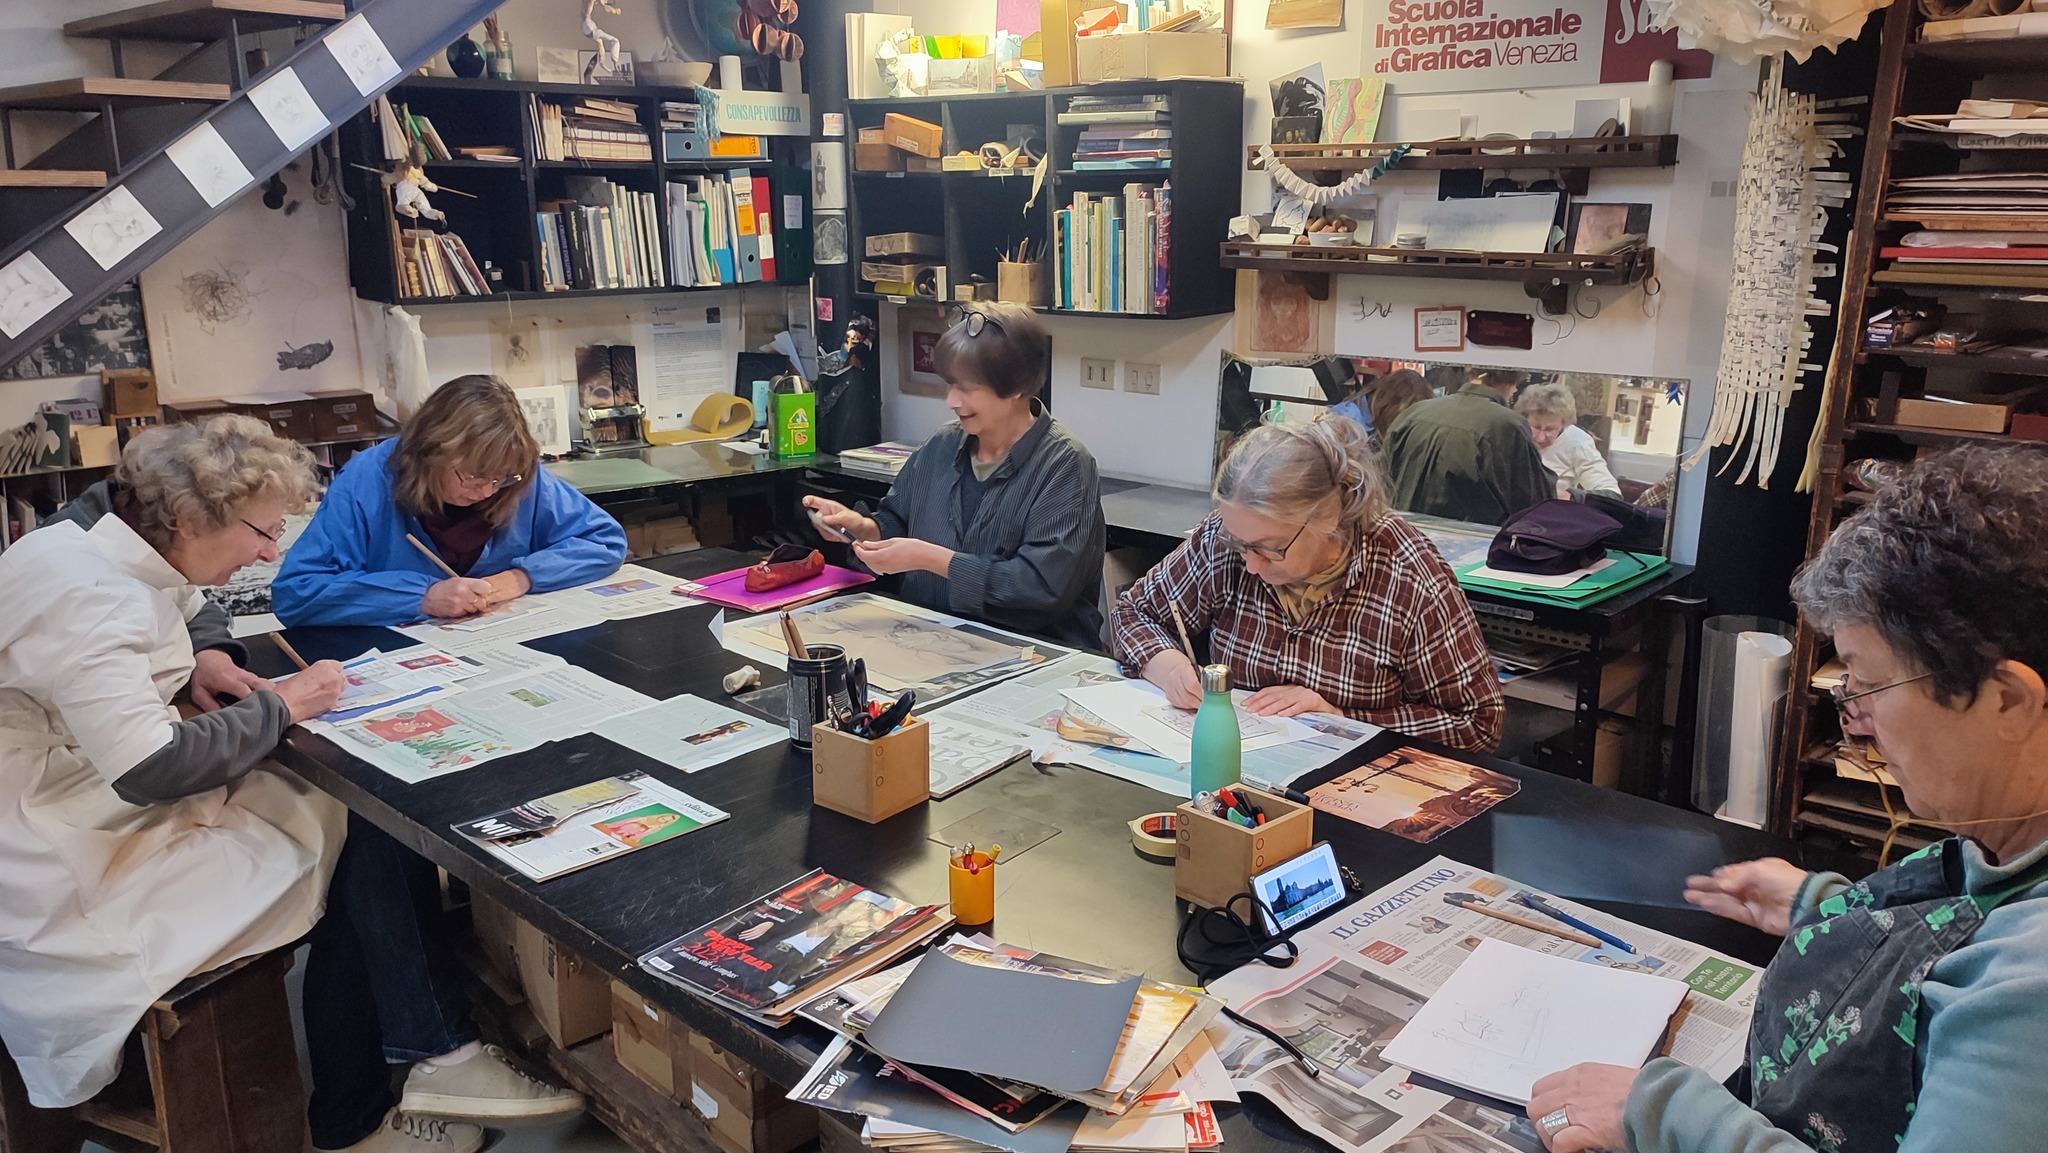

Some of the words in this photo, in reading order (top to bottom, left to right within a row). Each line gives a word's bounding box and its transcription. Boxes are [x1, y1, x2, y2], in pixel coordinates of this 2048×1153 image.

[1387, 0, 1483, 24] Scuola
[1375, 8, 1582, 48] Internazionale
[1374, 57, 1389, 74] di
[1390, 46, 1492, 73] Grafica
[1494, 37, 1578, 66] Venezia
[726, 103, 801, 123] CONSAPEVOLLEZZA
[1329, 924, 1360, 941] IL
[1350, 868, 1456, 928] GAZZETTINO
[704, 929, 755, 952] PREPPY
[707, 941, 740, 959] NEW
[737, 950, 773, 972] YEAR
[1689, 973, 1706, 986] Con
[1702, 967, 1714, 978] Te
[1703, 979, 1716, 991] nel
[1713, 966, 1734, 982] nostro
[1714, 972, 1744, 995] Territorio
[817, 1083, 838, 1101] IED
